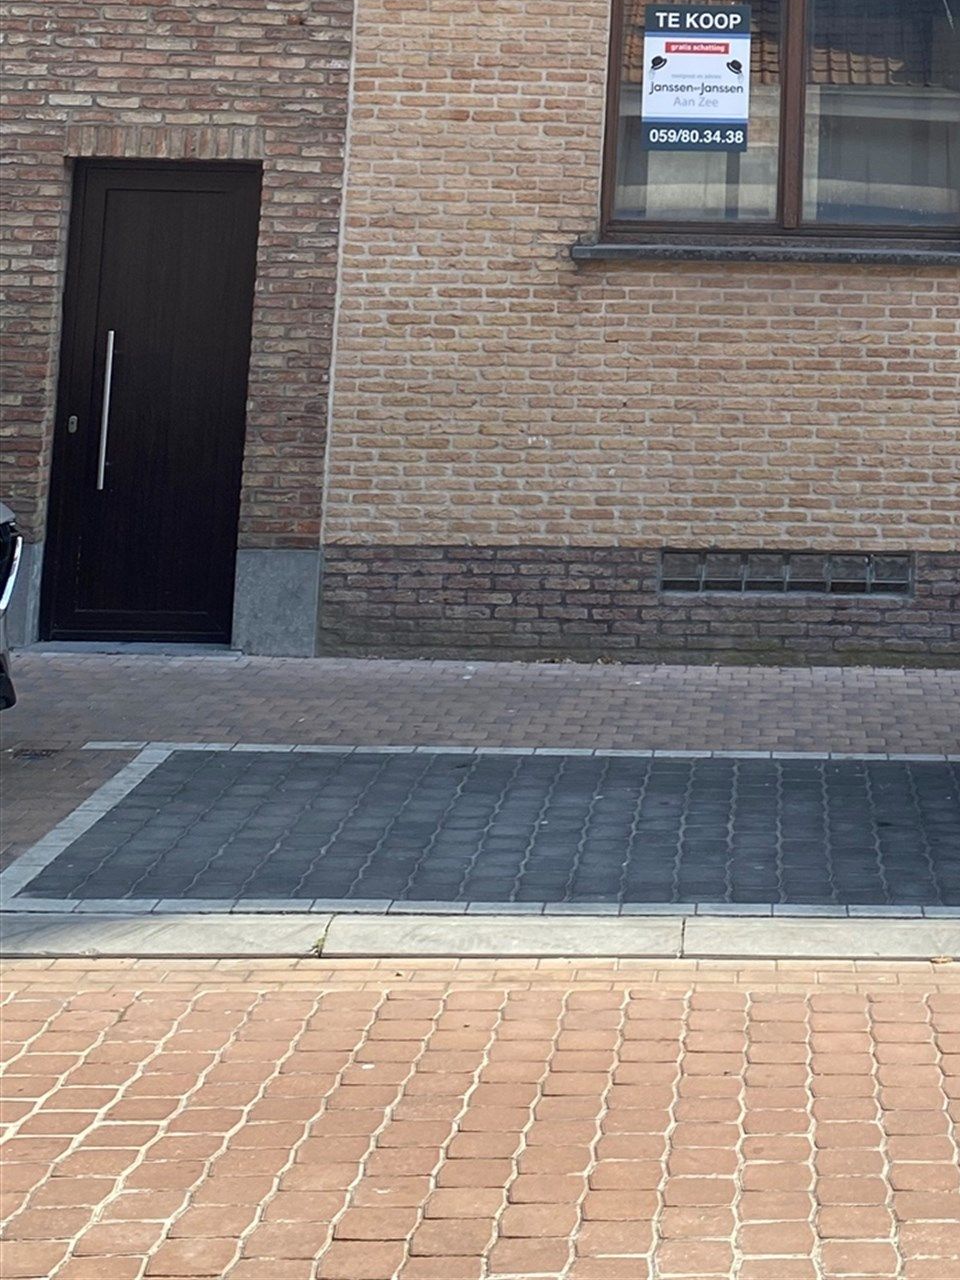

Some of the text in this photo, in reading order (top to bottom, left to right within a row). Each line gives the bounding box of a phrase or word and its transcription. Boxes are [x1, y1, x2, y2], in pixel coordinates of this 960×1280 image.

[655, 12, 741, 29] TE KOOP
[673, 97, 719, 108] Aan Zee
[650, 128, 743, 144] 059/80.34.38
